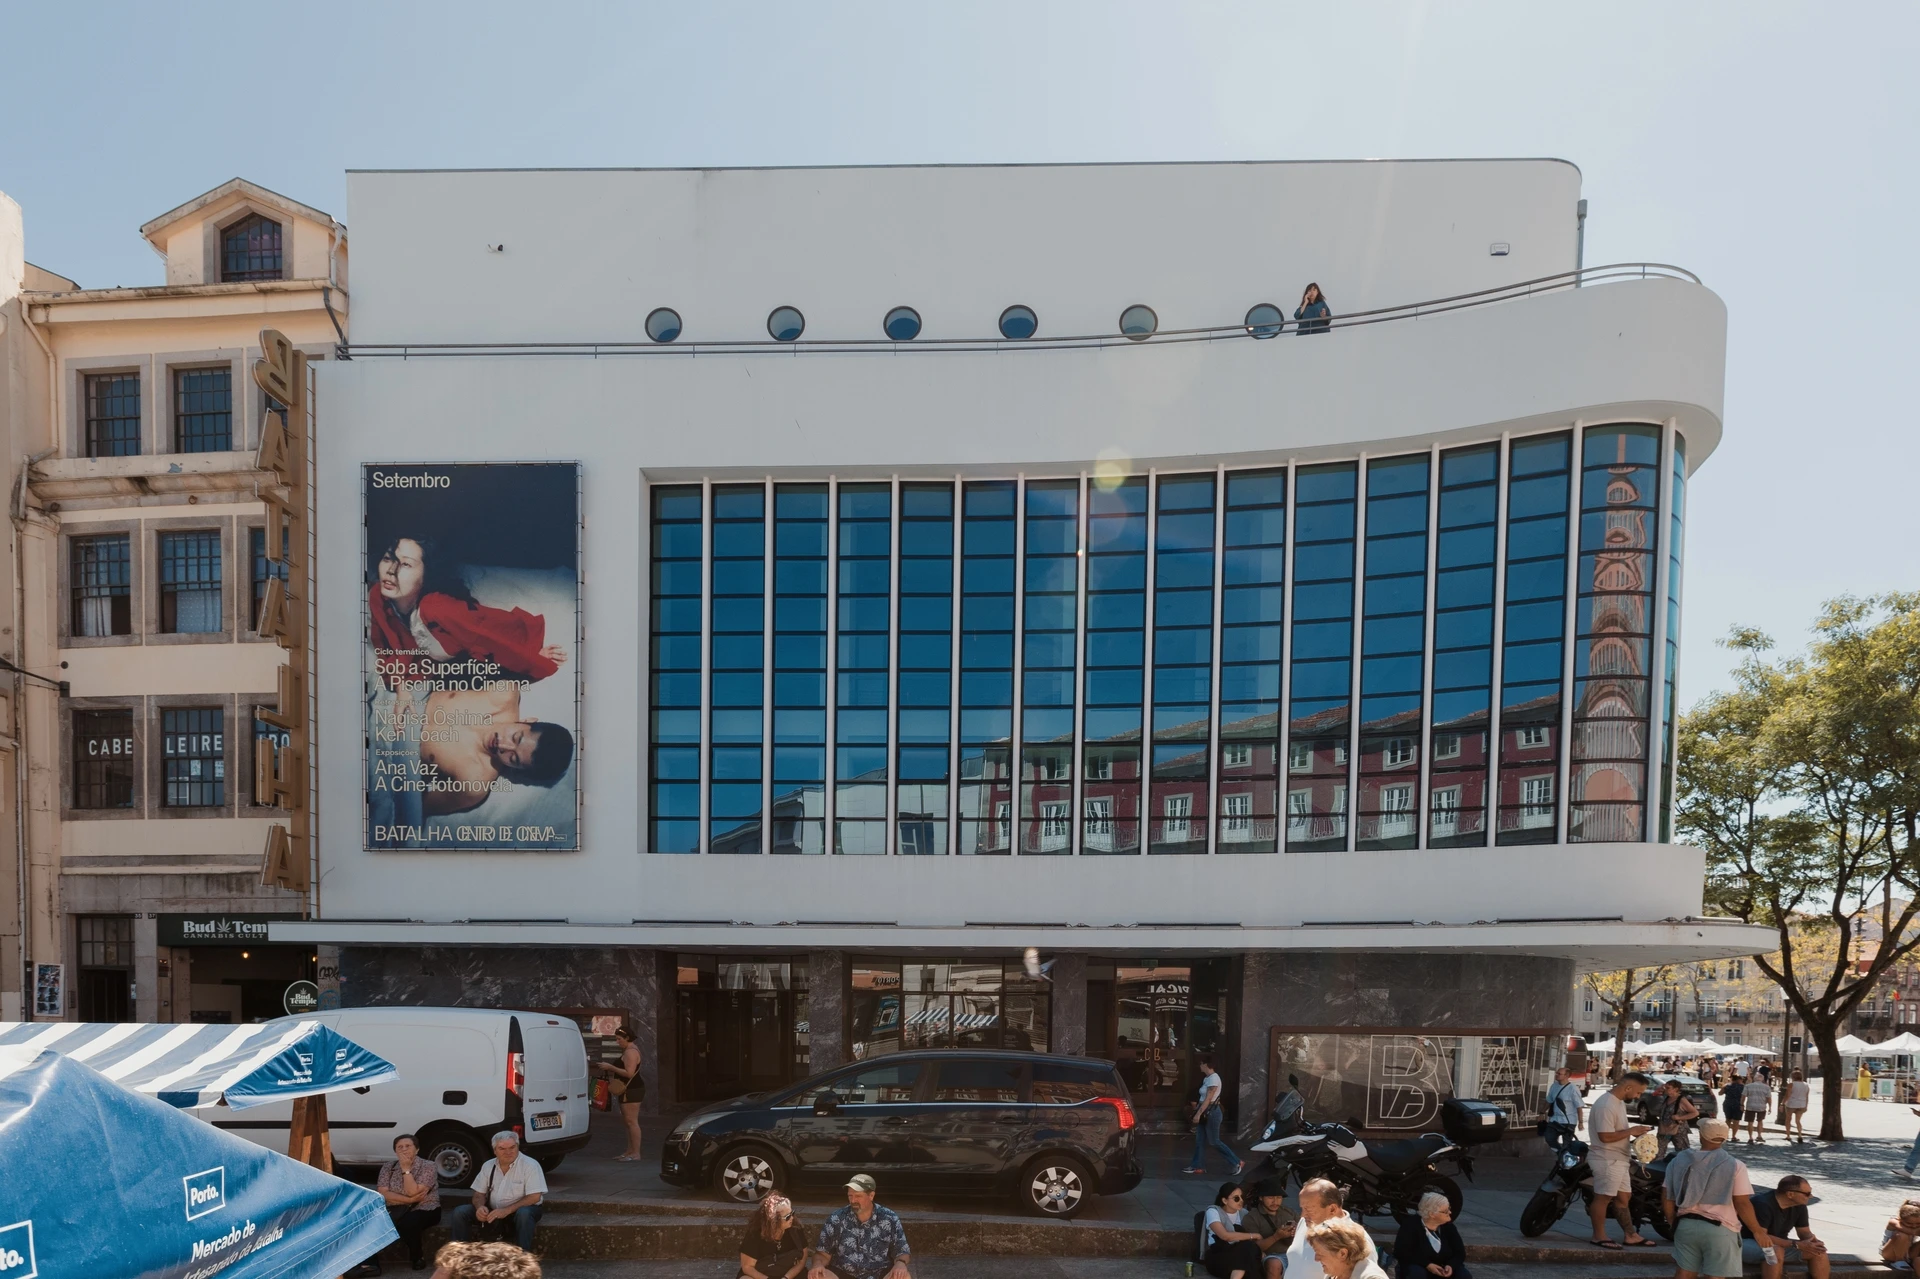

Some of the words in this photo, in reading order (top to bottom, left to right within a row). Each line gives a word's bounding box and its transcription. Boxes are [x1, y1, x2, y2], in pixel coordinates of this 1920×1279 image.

[372, 471, 450, 488] Setembro
[374, 648, 393, 656] Ciclo
[395, 647, 430, 656] temático
[374, 659, 405, 675] Sob
[408, 663, 418, 675] a
[421, 658, 500, 678] Superfície:
[374, 676, 386, 691] A
[390, 676, 445, 692] Piscina
[449, 679, 468, 691] no
[471, 676, 531, 692] Cinema
[375, 709, 428, 729] Nagisa
[433, 706, 493, 726] Ōshima
[375, 727, 406, 742] Ken
[411, 726, 459, 742] Loach
[89, 739, 133, 755] CABE
[166, 735, 222, 754] LEIRE
[375, 749, 419, 757] Exposições
[375, 759, 407, 775] Ana
[410, 759, 438, 775] Vaz
[375, 776, 387, 792] A
[391, 776, 513, 792] Cine-fotonovela
[375, 825, 453, 842] BATALHA
[183, 920, 215, 933] Bud
[290, 998, 317, 1006] Temple
[190, 1184, 219, 1206] Porto.
[191, 1225, 242, 1263] Mercado
[242, 1219, 256, 1239] de
